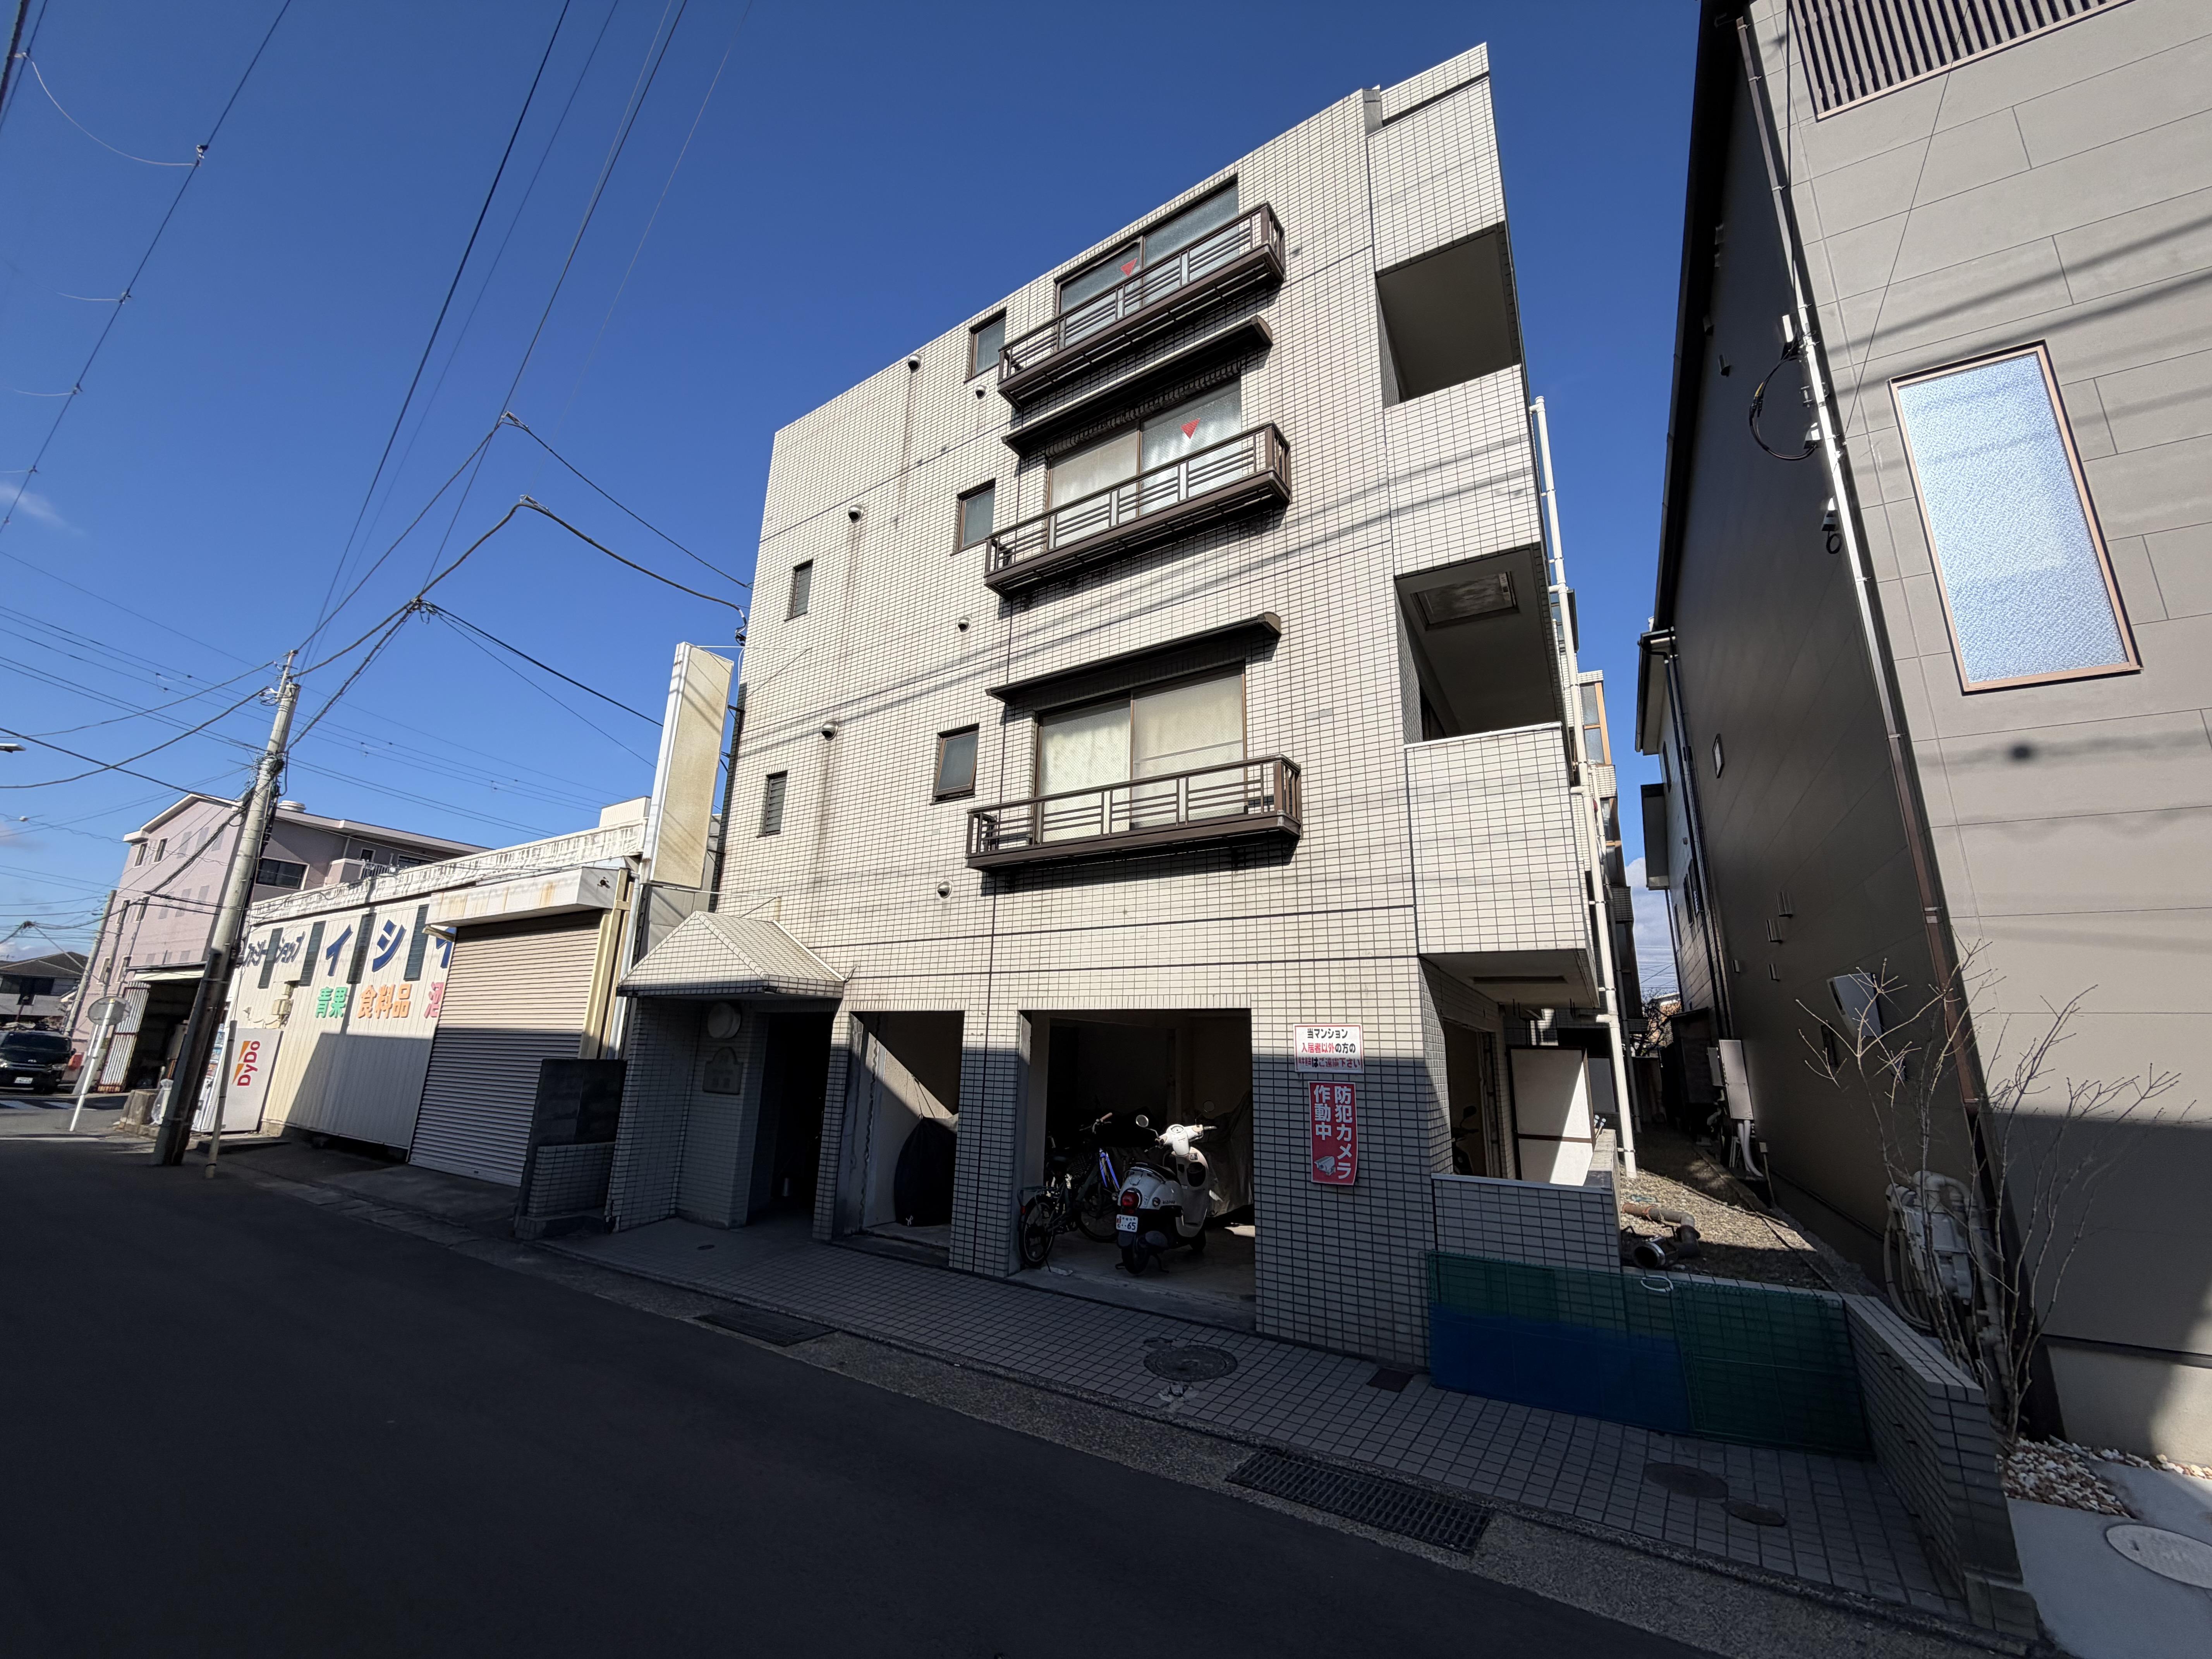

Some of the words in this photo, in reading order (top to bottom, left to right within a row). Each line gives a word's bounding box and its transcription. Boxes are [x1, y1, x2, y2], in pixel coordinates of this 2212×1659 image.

[315, 986, 348, 1018] 青果
[357, 983, 412, 1019] 食料品
[1302, 1042, 1356, 1054] 入居者以外の方の
[1307, 1028, 1348, 1039] 当マンション
[237, 1041, 261, 1086] DyDo
[1314, 1085, 1332, 1140] 作動中
[1334, 1086, 1353, 1179] 防犯カメラ
